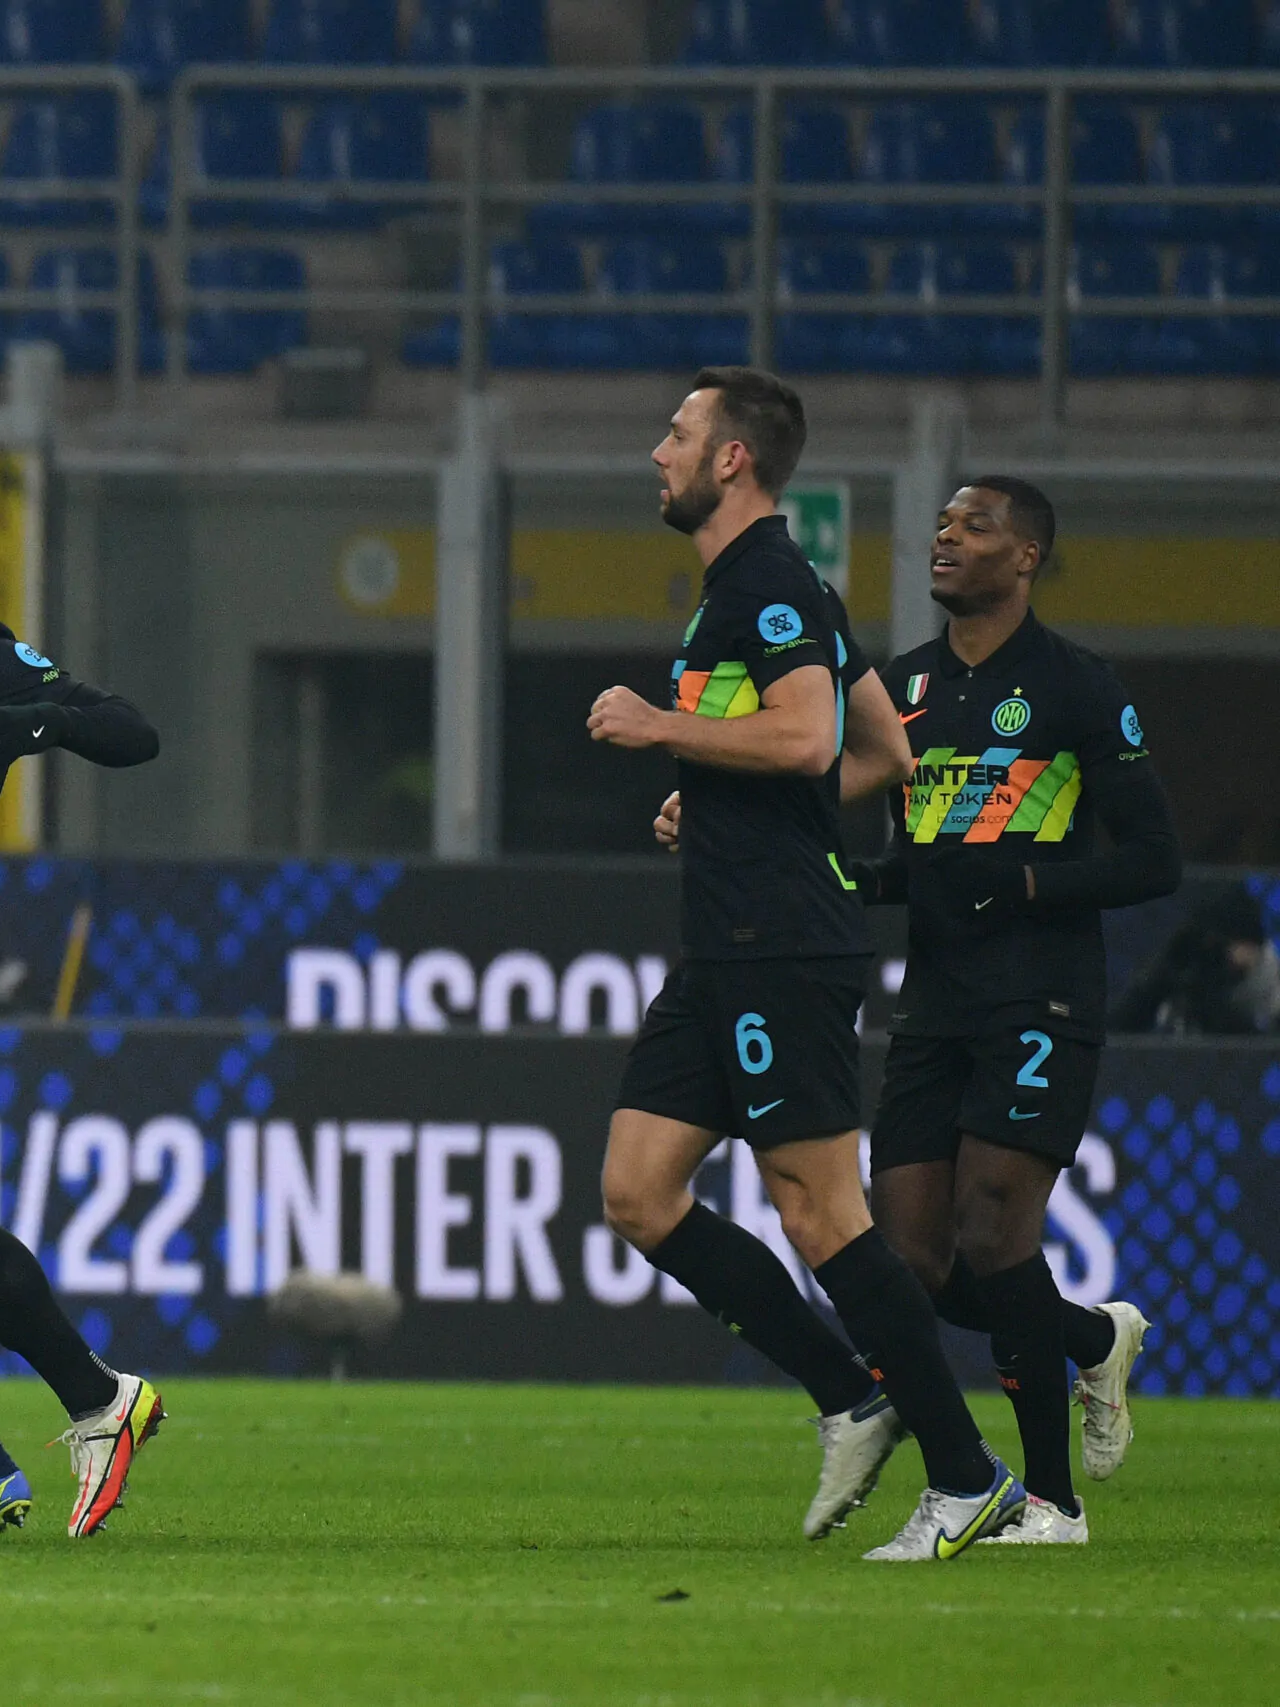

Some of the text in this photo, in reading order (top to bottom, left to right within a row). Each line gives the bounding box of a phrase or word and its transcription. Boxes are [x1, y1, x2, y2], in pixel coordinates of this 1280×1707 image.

[939, 792, 1013, 806] TOKEN
[735, 1012, 774, 1075] 6
[1016, 1029, 1054, 1089] 2
[225, 1117, 566, 1302] INTER
